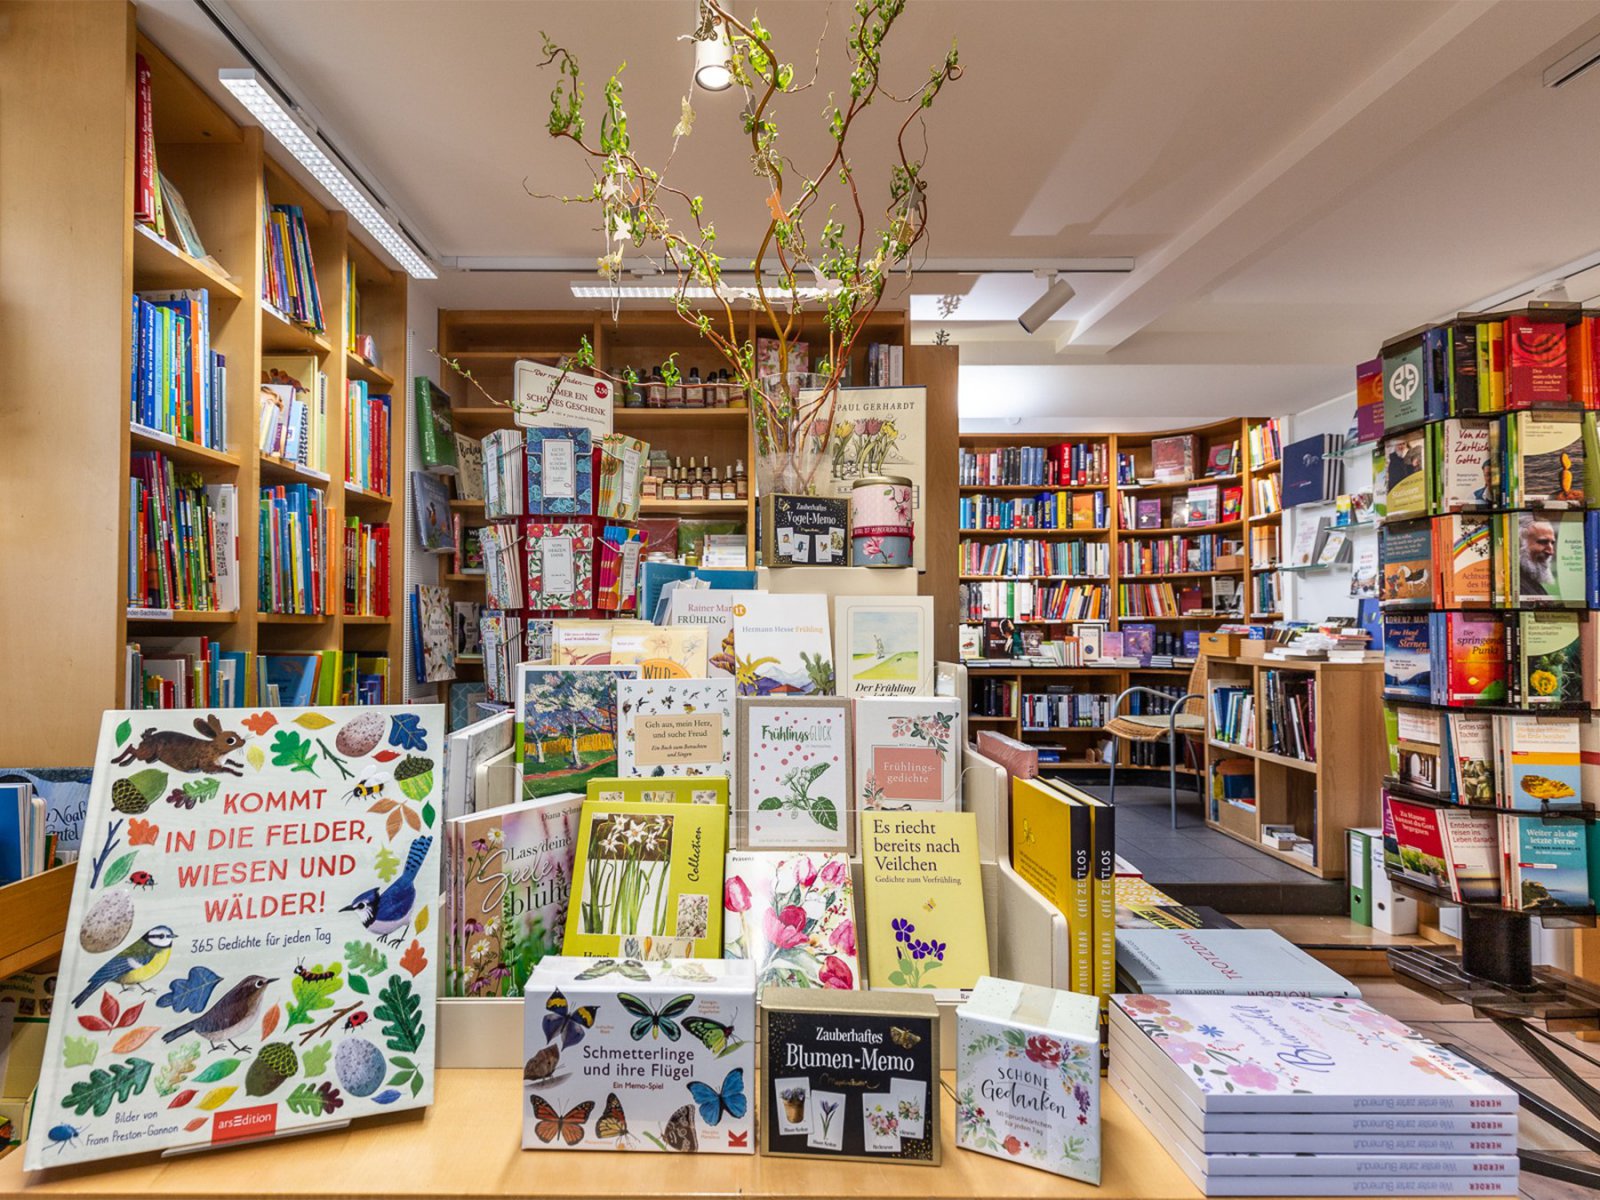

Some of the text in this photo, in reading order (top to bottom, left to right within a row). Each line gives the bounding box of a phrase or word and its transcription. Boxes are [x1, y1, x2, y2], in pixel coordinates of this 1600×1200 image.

[575, 392, 588, 401] EIN
[565, 401, 606, 416] GESCHENK
[837, 402, 916, 411] PAUL GERHARDT
[786, 511, 837, 525] Vogel-Memo
[688, 603, 714, 613] Rainer
[677, 614, 726, 626] FRÜHLING
[742, 625, 823, 635] Hermann Hesse Frühling
[643, 664, 678, 679] WILD-
[855, 682, 872, 693] Der
[874, 682, 916, 695] Frühling
[694, 720, 712, 729] Herz,
[688, 730, 707, 738] Freud
[883, 760, 936, 774] Frühlings-
[887, 773, 929, 785] gedichte
[223, 788, 328, 816] KOMMT
[53, 800, 87, 826] Noah
[873, 820, 936, 835] Es riecht
[1526, 829, 1578, 837] Weiter als die
[165, 819, 374, 854] IN DIE FELDER,
[1530, 837, 1576, 845] letzte Ferne
[510, 836, 572, 862] Lass deine
[874, 838, 961, 854] bereits nach
[690, 826, 702, 883] Collection
[875, 856, 937, 872] Veilchen
[177, 854, 356, 890] WIESEN UND
[1077, 849, 1087, 895] ZEITLOS
[1101, 849, 1111, 895] ZEITLOS
[477, 850, 553, 914] Seele
[875, 875, 962, 886] Gedichte zum Vorfrühling
[510, 878, 570, 917] blühe
[204, 890, 327, 924] WÄLDER!
[190, 928, 332, 954] 365 Gedichte für jeden Tag
[1175, 932, 1242, 980] TROTZDEM
[815, 1026, 883, 1045] Zauberhaftes
[583, 1045, 694, 1062] Schmetterlinge
[786, 1043, 914, 1073] Blumen-Memo
[583, 1063, 694, 1080] und ihre Flügel
[998, 1067, 1049, 1090] SCHÖNE
[613, 1082, 664, 1091] Ein Memo-Spiel
[981, 1078, 1067, 1119] Gedanken
[1353, 1098, 1394, 1109] Blumenduft
[114, 1110, 158, 1126] Bilder von
[1005, 1112, 1053, 1129] Spruchkärtchen
[1353, 1119, 1394, 1130] Blumenduft
[1470, 1121, 1502, 1129] HERDER
[86, 1124, 179, 1147] Frann Preston-Gannon
[1013, 1122, 1031, 1132] jeden
[1032, 1127, 1044, 1137] Tag
[1353, 1139, 1394, 1150] Blumenduft
[1356, 1161, 1398, 1172] Blumenduft
[1473, 1163, 1505, 1171] HERDER
[1353, 1181, 1394, 1192] Blumenduft
[1470, 1183, 1502, 1191] HERDER
